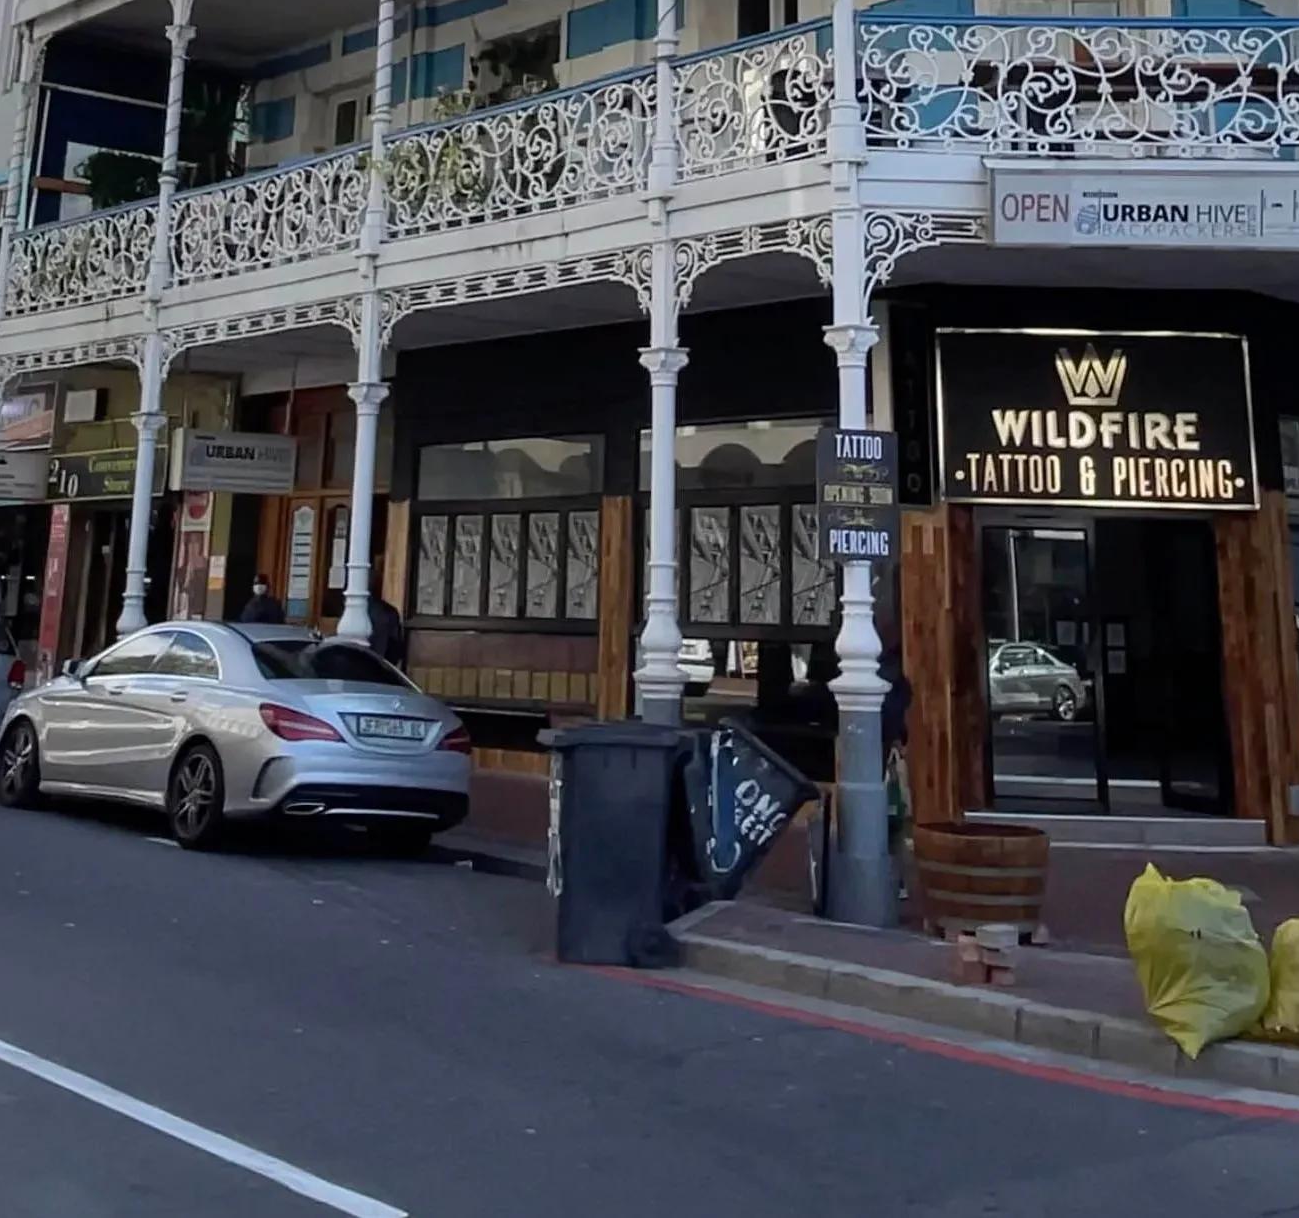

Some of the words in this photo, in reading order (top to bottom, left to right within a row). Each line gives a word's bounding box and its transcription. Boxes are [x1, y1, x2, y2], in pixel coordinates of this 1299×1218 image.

[1001, 193, 1069, 222] OPEN
[1103, 204, 1188, 222] URBAN
[1197, 204, 1246, 222] HIVE
[991, 409, 1201, 451] WILDFIRE
[206, 445, 256, 460] URBAN
[835, 434, 883, 460] TATTOO
[966, 453, 1061, 494] TATTOO
[1079, 455, 1097, 496] &
[1113, 456, 1234, 499] PIERCING
[830, 530, 888, 555] PIERCING
